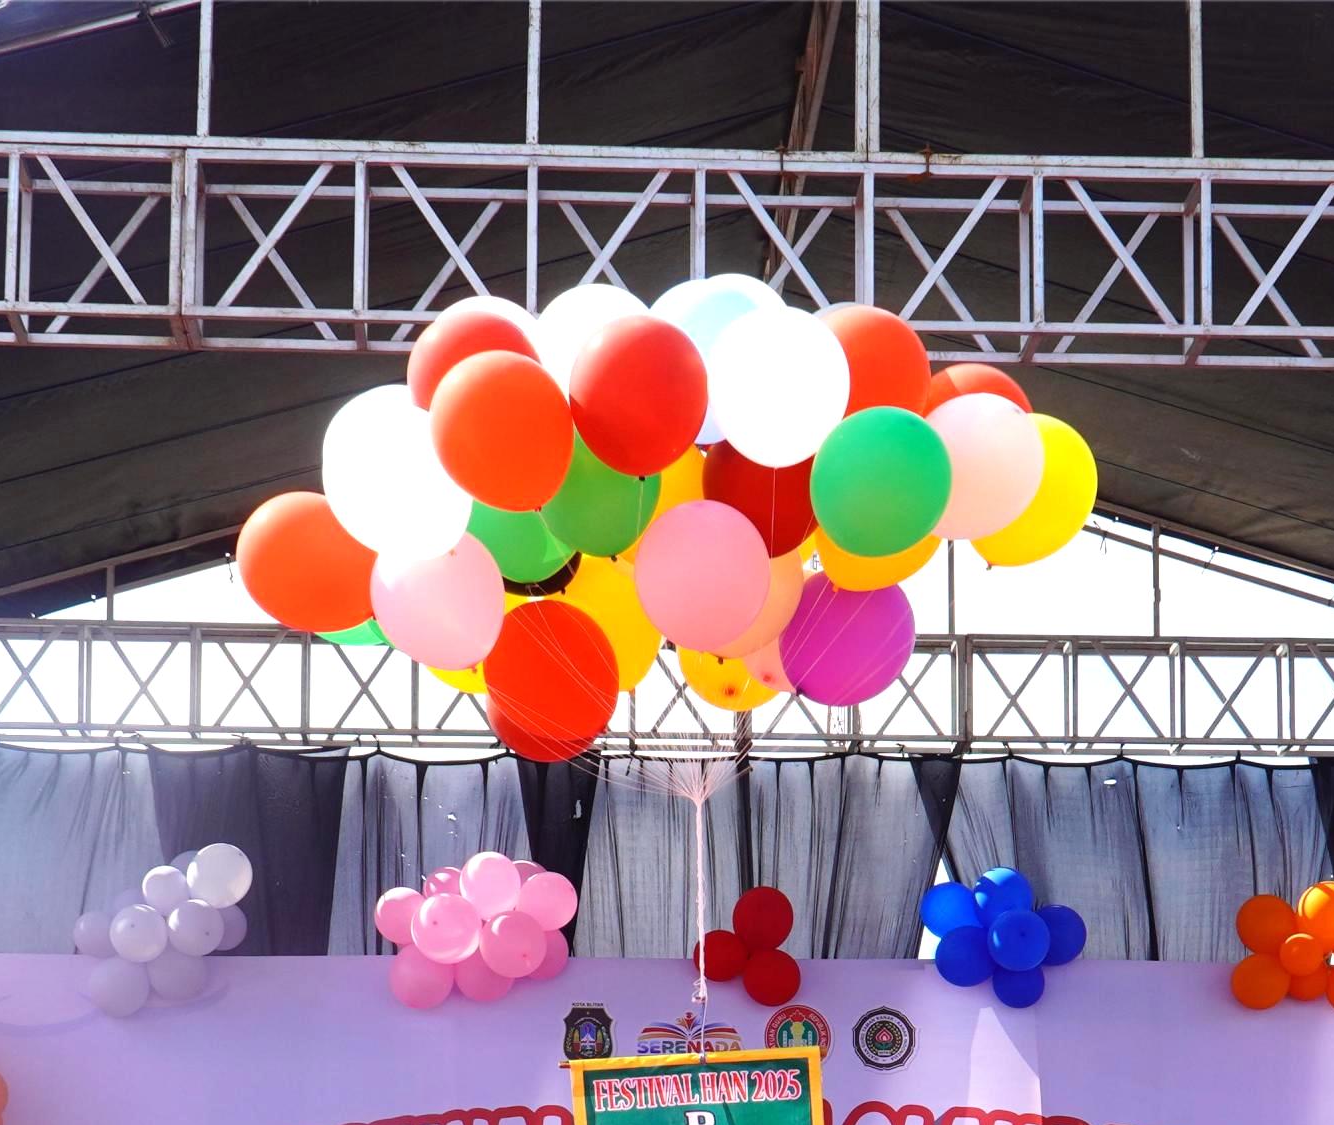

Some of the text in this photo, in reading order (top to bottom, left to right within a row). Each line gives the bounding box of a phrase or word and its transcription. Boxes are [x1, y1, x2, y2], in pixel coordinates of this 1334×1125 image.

[637, 1040, 741, 1054] SERENADA
[593, 1068, 802, 1112] FESTIVAL HAN 2025
